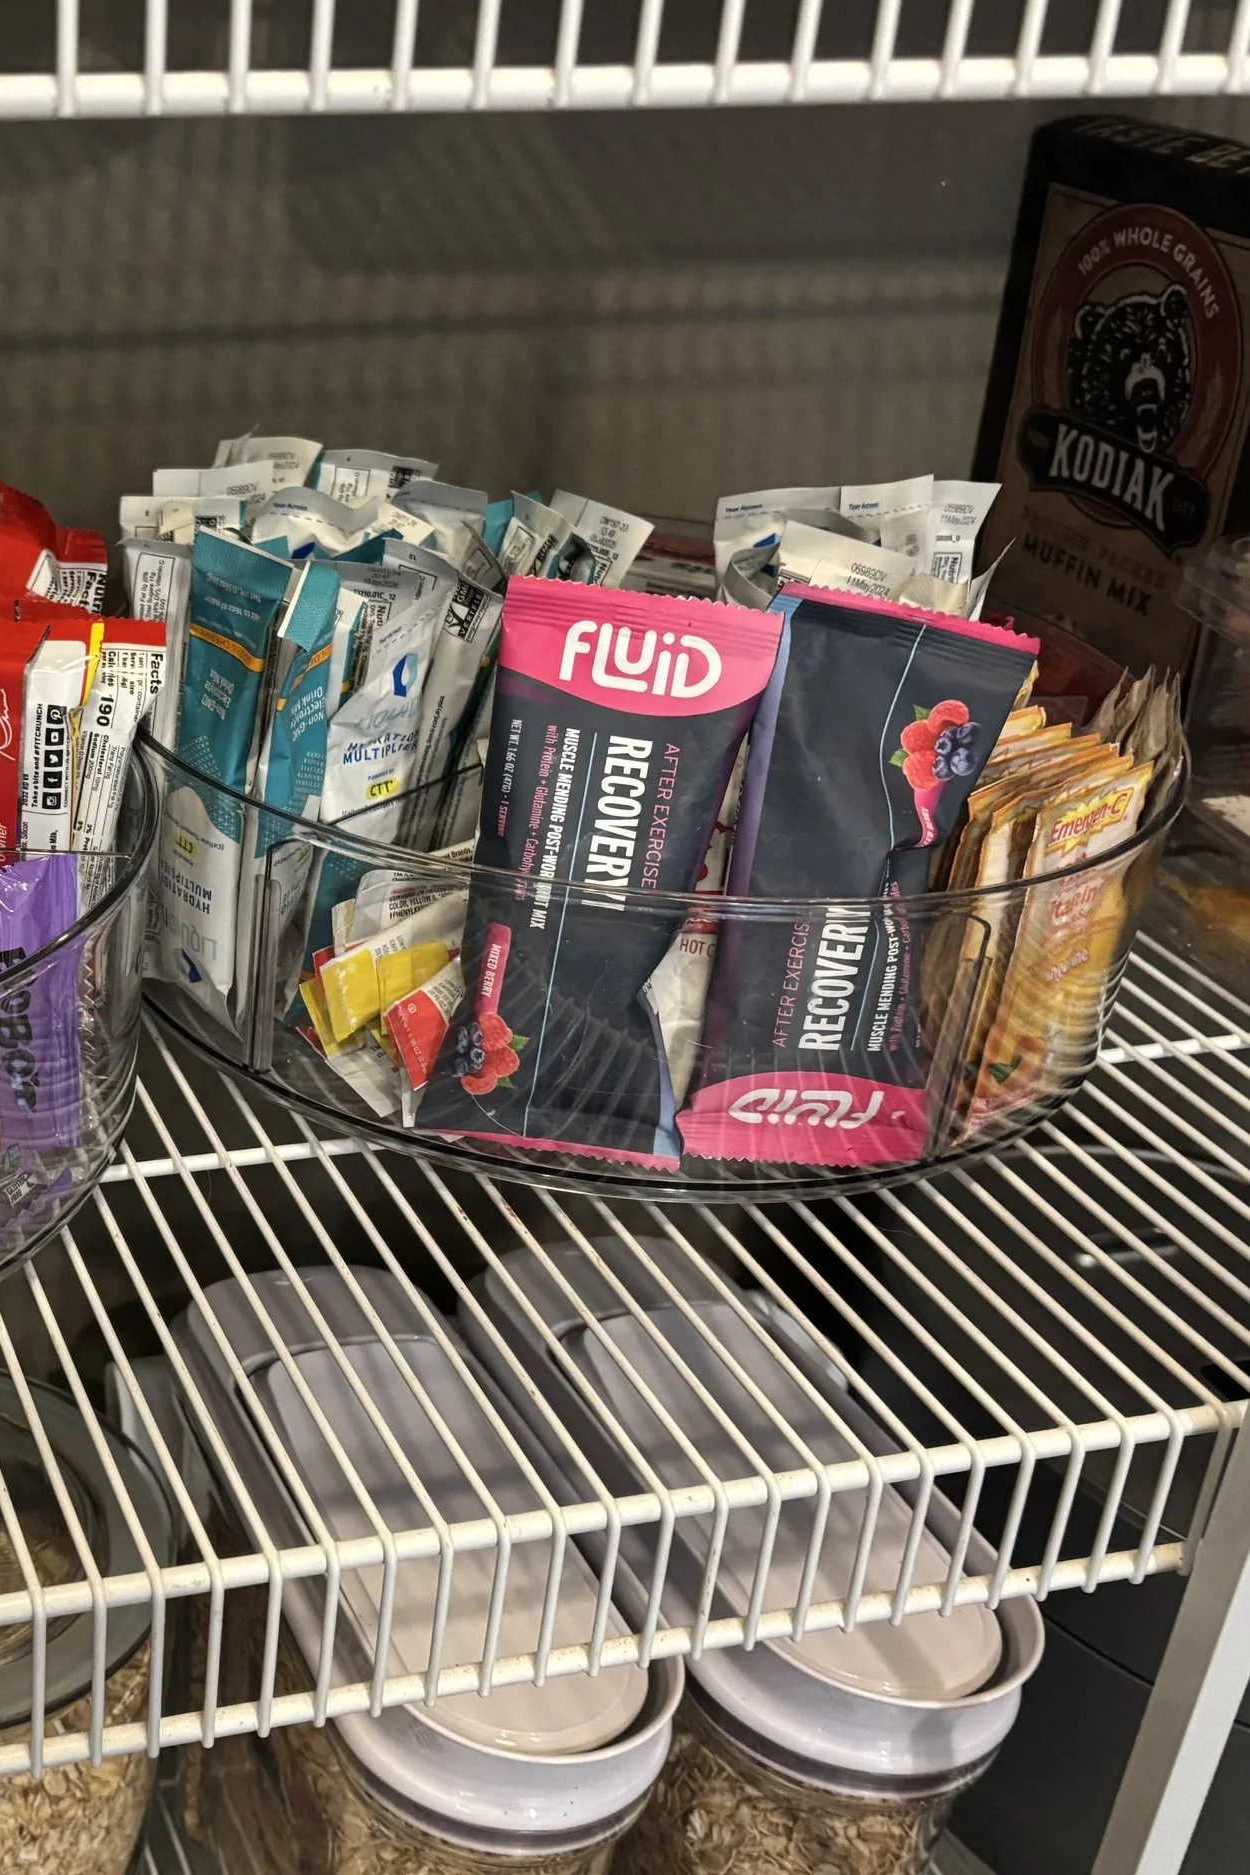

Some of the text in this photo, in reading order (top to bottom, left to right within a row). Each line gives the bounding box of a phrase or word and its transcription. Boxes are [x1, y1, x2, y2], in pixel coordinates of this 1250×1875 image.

[1078, 226, 1220, 319] 100% WHOLE GRAINS
[1048, 422, 1175, 532] KODIAK
[1023, 532, 1152, 616] MUFFIN MIX
[150, 653, 163, 695] Facts
[300, 686, 323, 704] Drink
[35, 703, 43, 755] #FITCRUNCH
[96, 694, 114, 727] 190
[512, 719, 523, 732] NET
[90, 733, 99, 758] Sodium
[99, 734, 109, 770] Cholesterol
[507, 747, 517, 763] 1.66
[509, 732, 519, 746] WT.
[560, 728, 581, 771] MUSCLE
[528, 725, 557, 830] with Protein Glutamine
[658, 743, 680, 801] AFTER
[551, 773, 573, 822] MENDING
[160, 859, 212, 901] MULTIPLIE
[161, 875, 210, 915] HYDRATIO
[530, 911, 547, 930] MIX
[680, 938, 698, 955] HOT
[486, 943, 502, 998] MIXED BERRY
[772, 922, 810, 1049] AFTER EXERCIS
[867, 965, 897, 1052] MUSCLE MENDING
